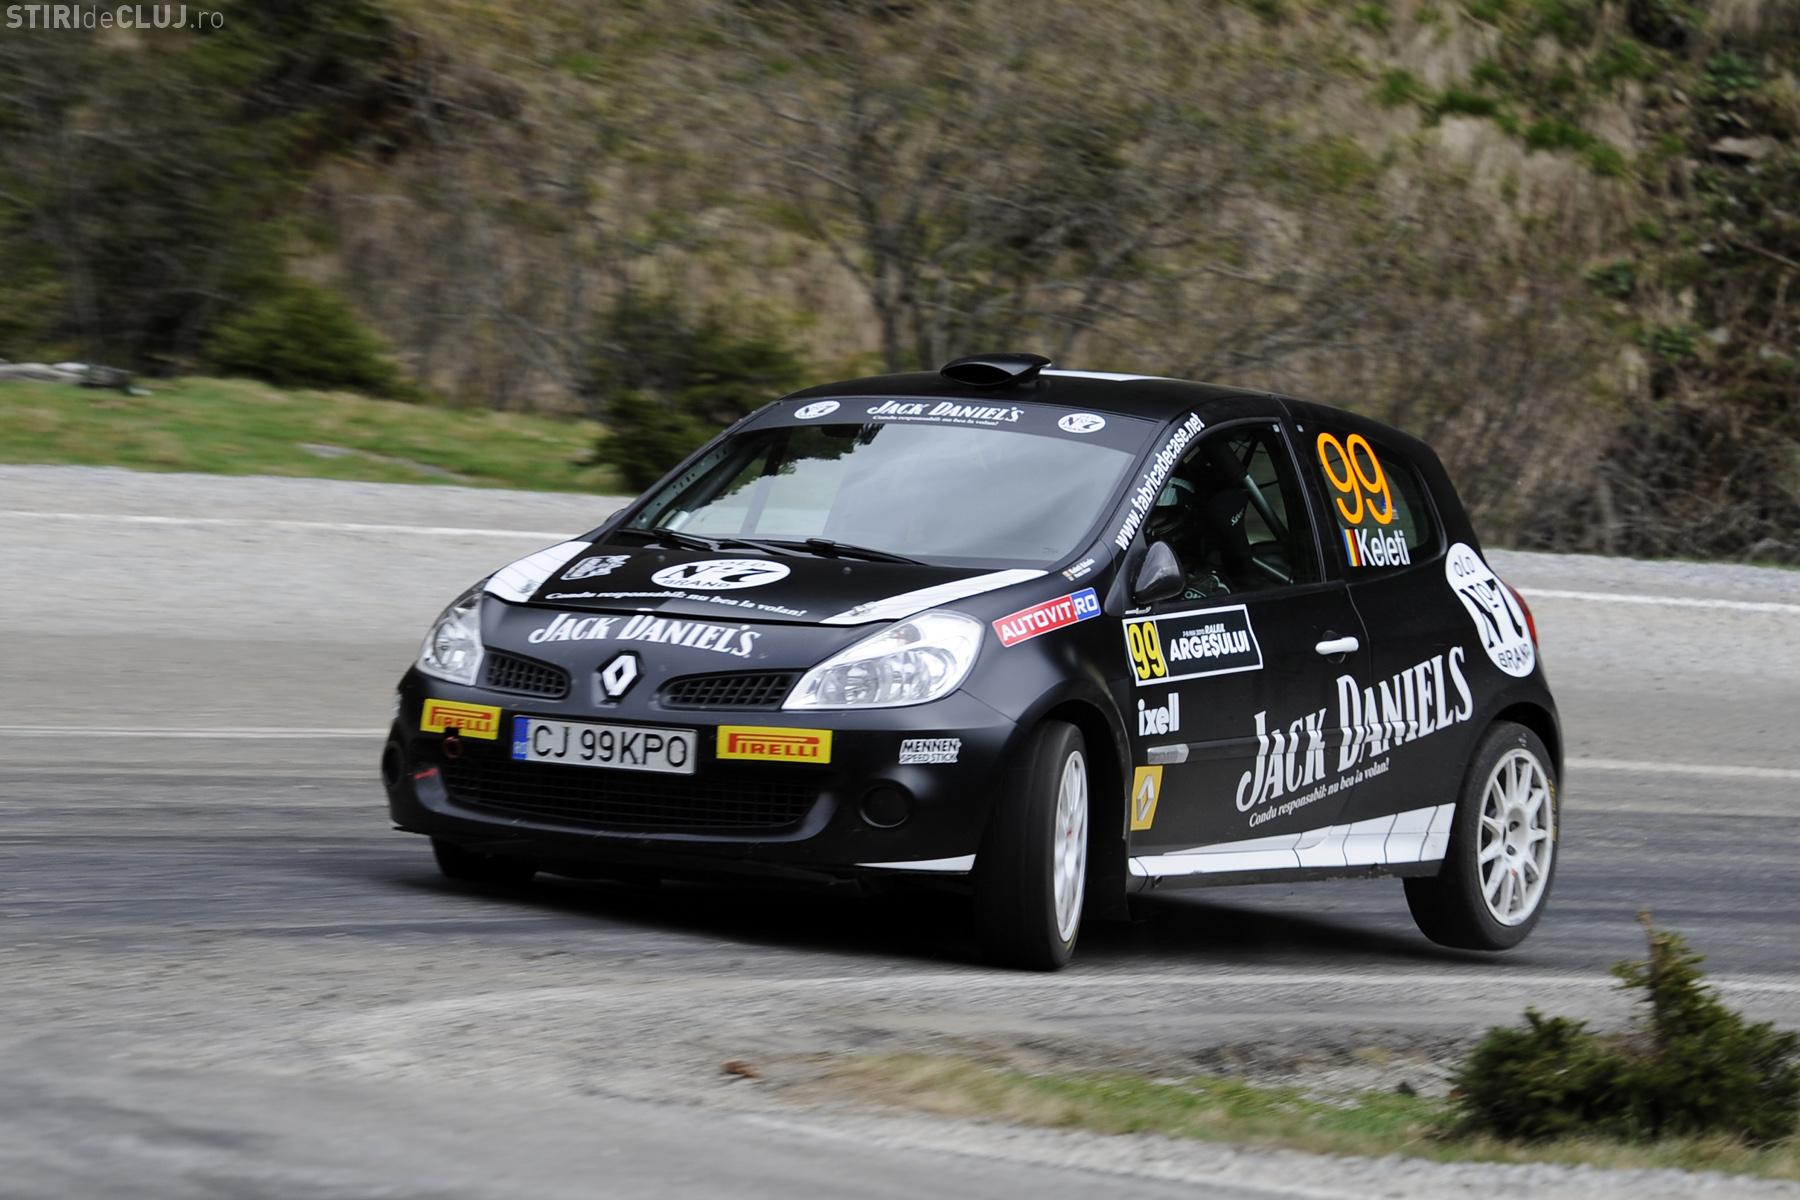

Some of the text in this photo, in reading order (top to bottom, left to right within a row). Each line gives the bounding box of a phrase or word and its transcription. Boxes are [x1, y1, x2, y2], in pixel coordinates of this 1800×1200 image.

[866, 400, 1025, 422] JACK DANIEL'S
[1115, 412, 1205, 551] www.fabricadecase.net
[1317, 432, 1393, 525] 99
[1354, 528, 1411, 567] Keleti
[661, 579, 732, 588] BRAND
[528, 613, 762, 659] JACK DANIEL'S
[1128, 621, 1167, 680] 99
[430, 706, 493, 733] PIRELLI
[1137, 692, 1180, 737] ixell
[1236, 646, 1474, 812] JACK DANIELS
[533, 724, 571, 758] CJ
[728, 733, 820, 757] PIRELLI
[901, 739, 959, 753] MENNEN
[1250, 804, 1277, 828] Condu
[1327, 780, 1339, 796] nu
[1339, 774, 1354, 790] bea
[1364, 756, 1389, 780] volan!
